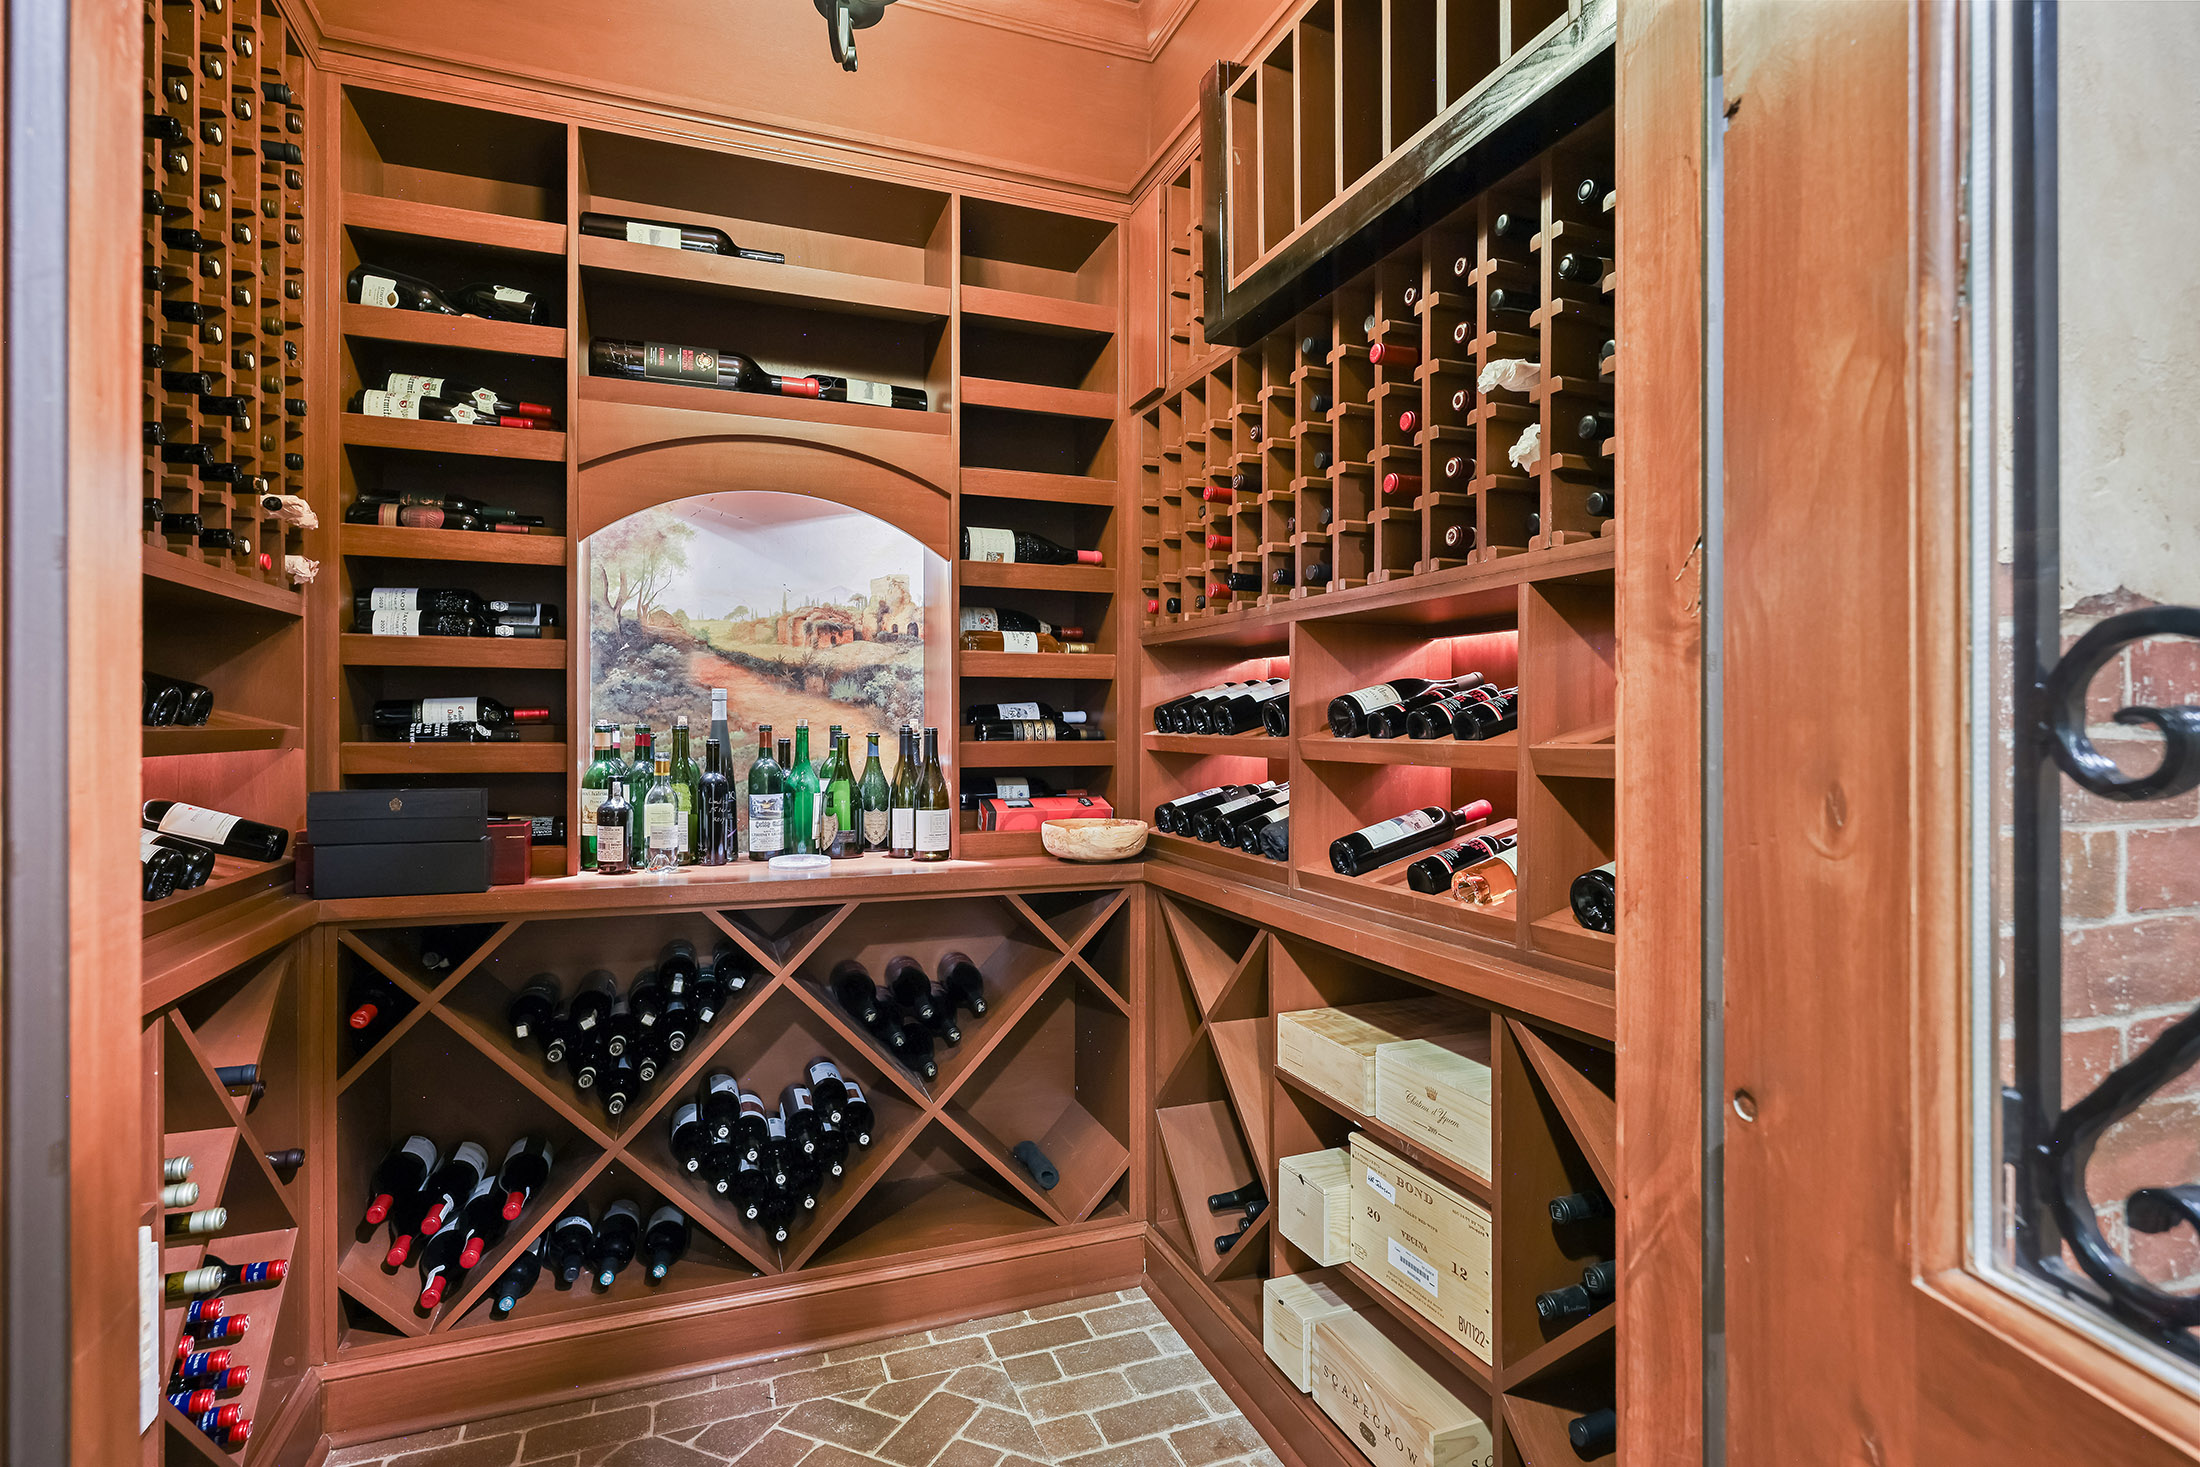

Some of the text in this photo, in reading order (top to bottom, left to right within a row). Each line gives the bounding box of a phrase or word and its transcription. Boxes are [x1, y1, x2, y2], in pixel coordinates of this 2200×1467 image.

[1395, 1175, 1434, 1205] BOND
[1366, 1206, 1381, 1223] 20
[1450, 1261, 1468, 1281] 12
[1400, 1229, 1429, 1254] VECINA
[1458, 1315, 1486, 1349] BV1122
[1323, 1364, 1418, 1466] SCARECROW
